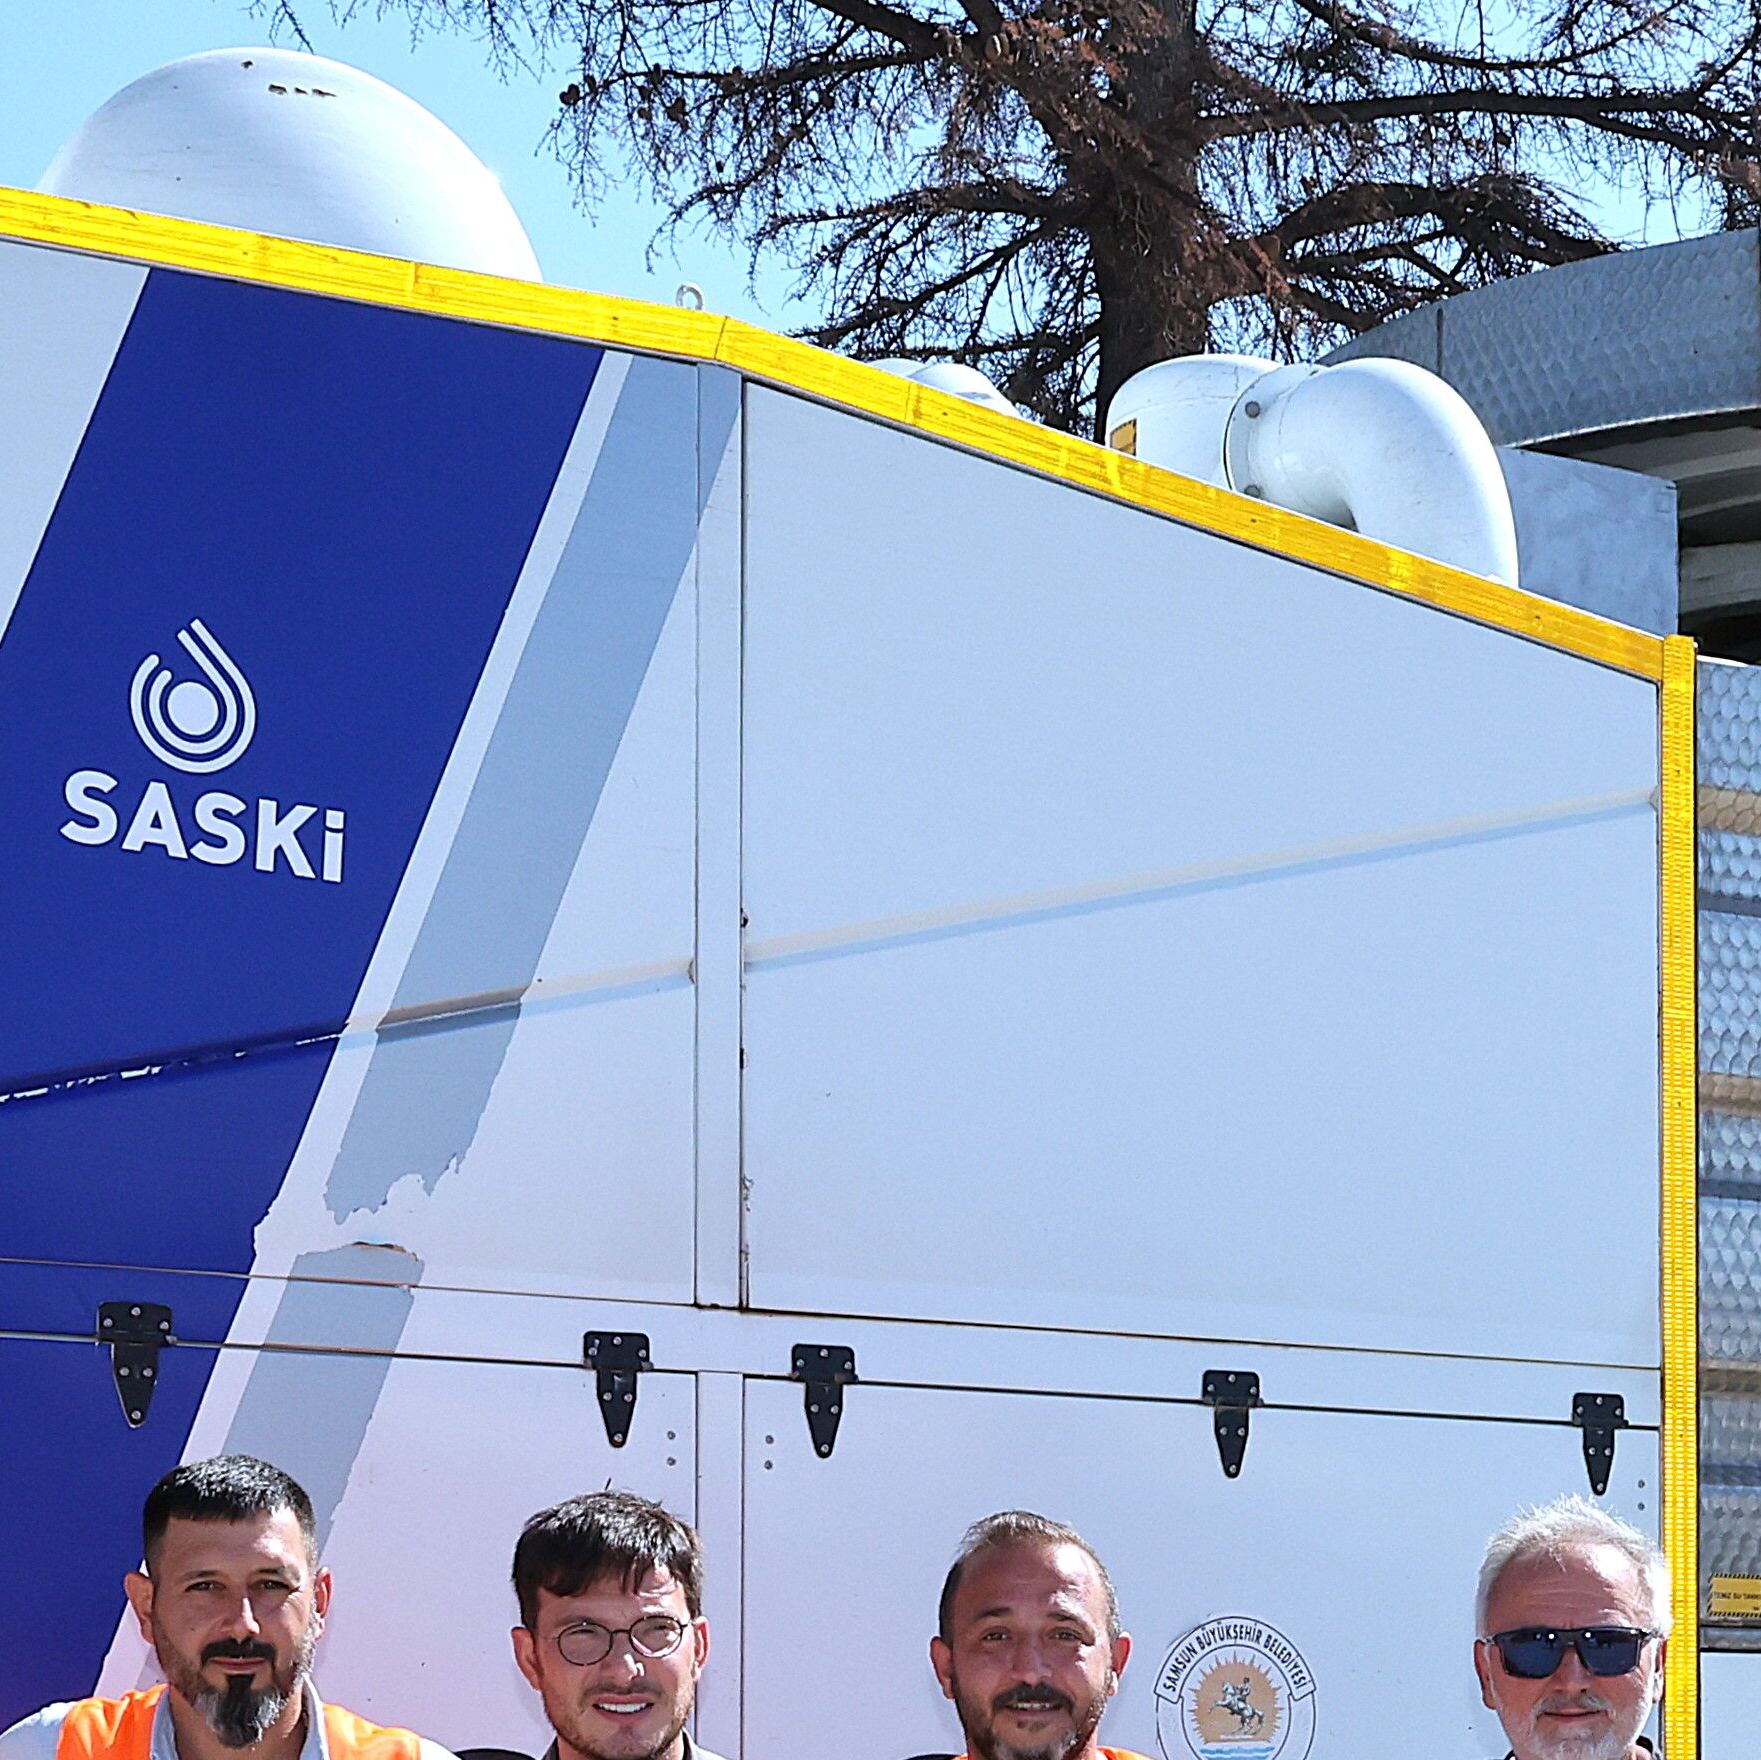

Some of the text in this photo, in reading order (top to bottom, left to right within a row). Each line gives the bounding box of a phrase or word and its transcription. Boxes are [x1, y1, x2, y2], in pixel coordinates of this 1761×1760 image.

[1162, 1621, 1312, 1692] SAMSUN BÜYÜKŞEHİR BELEDİYESİ
